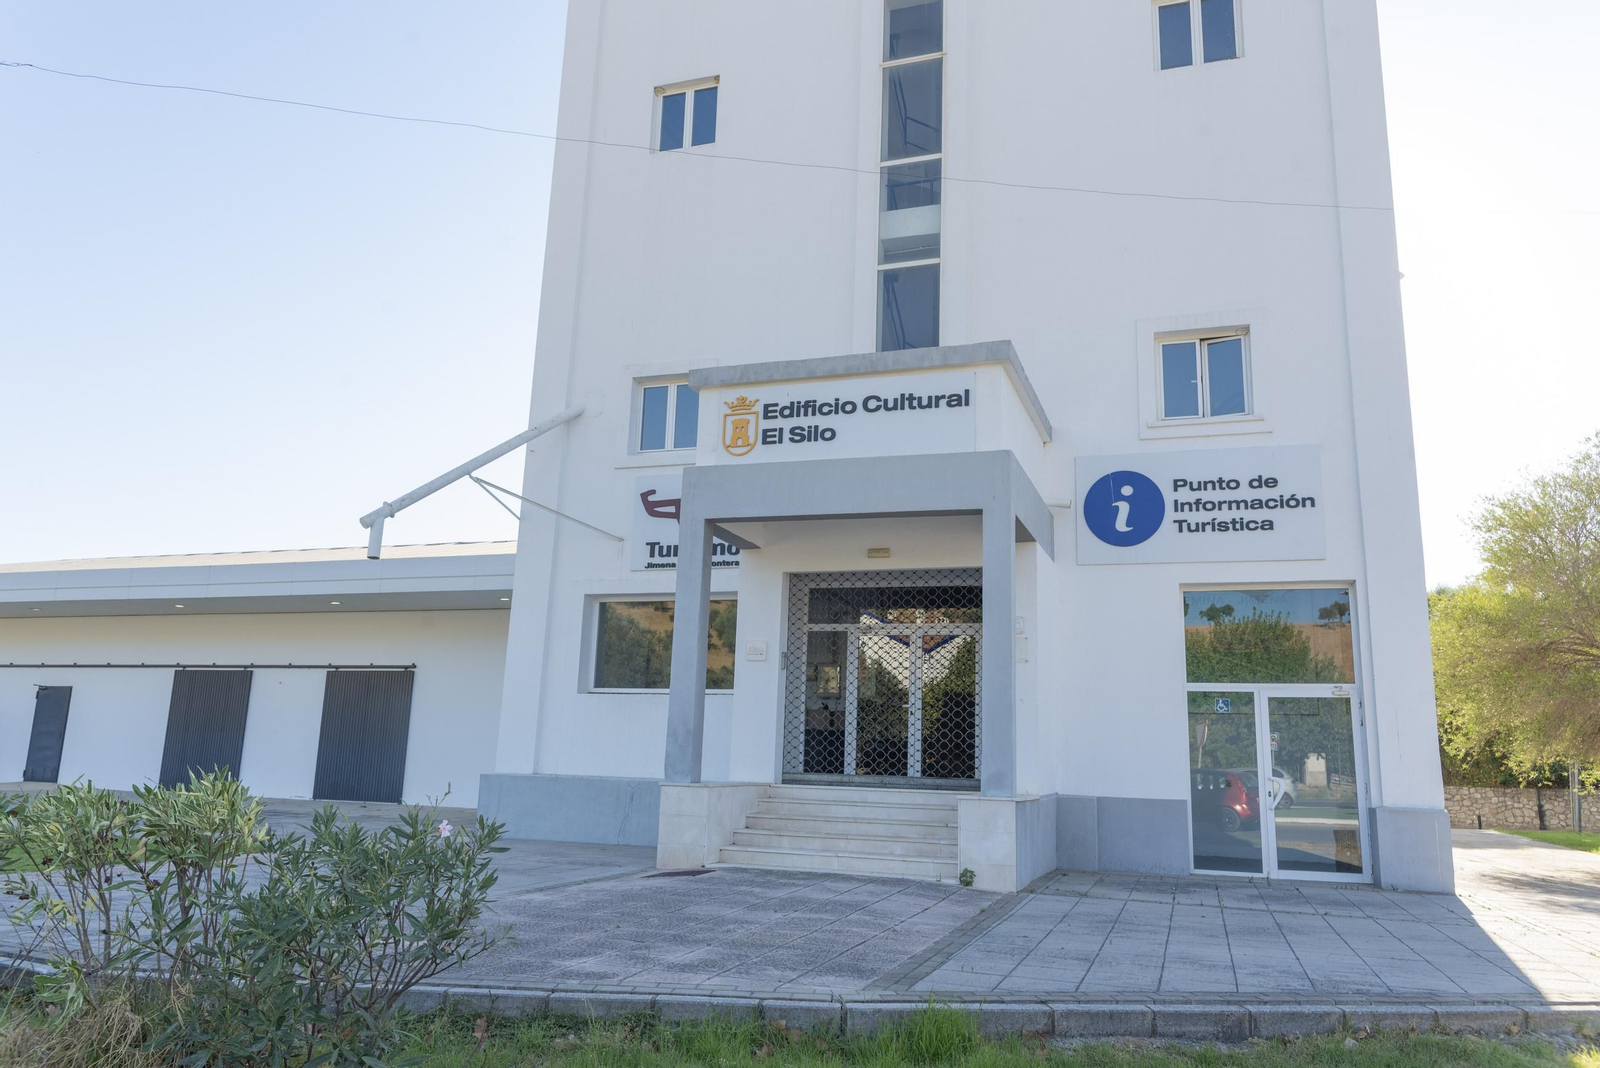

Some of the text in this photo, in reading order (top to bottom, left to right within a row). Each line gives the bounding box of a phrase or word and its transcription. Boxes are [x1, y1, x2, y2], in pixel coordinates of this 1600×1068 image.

[763, 389, 970, 420] Edificio Cultural
[762, 425, 837, 445] El Silo
[1173, 475, 1279, 492] Punto de
[1173, 494, 1315, 512] Información
[1173, 517, 1274, 533] Turística
